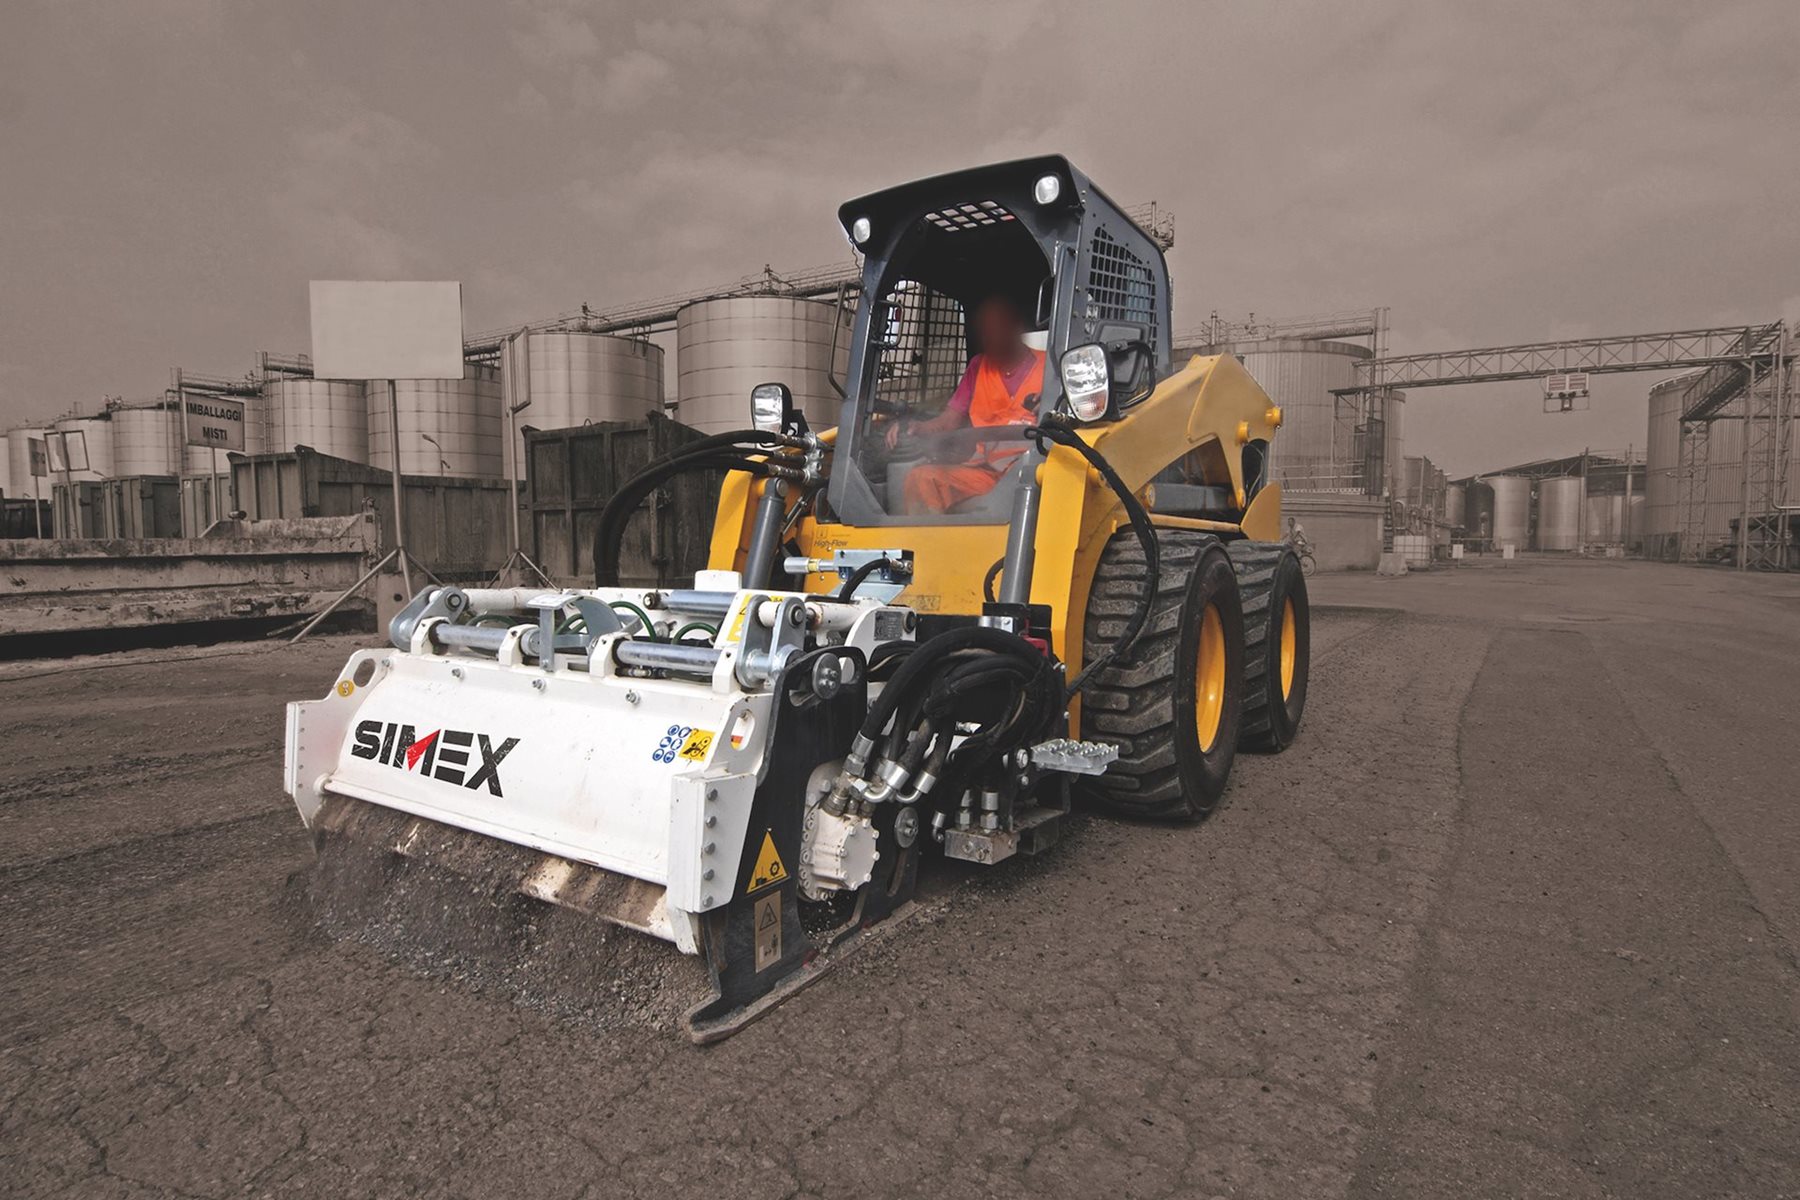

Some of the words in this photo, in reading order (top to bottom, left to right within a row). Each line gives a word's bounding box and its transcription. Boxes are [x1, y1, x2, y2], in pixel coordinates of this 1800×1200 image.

[186, 402, 242, 422] IMBALLAGGI
[202, 427, 228, 440] MISTI
[351, 719, 521, 798] SIMEX
